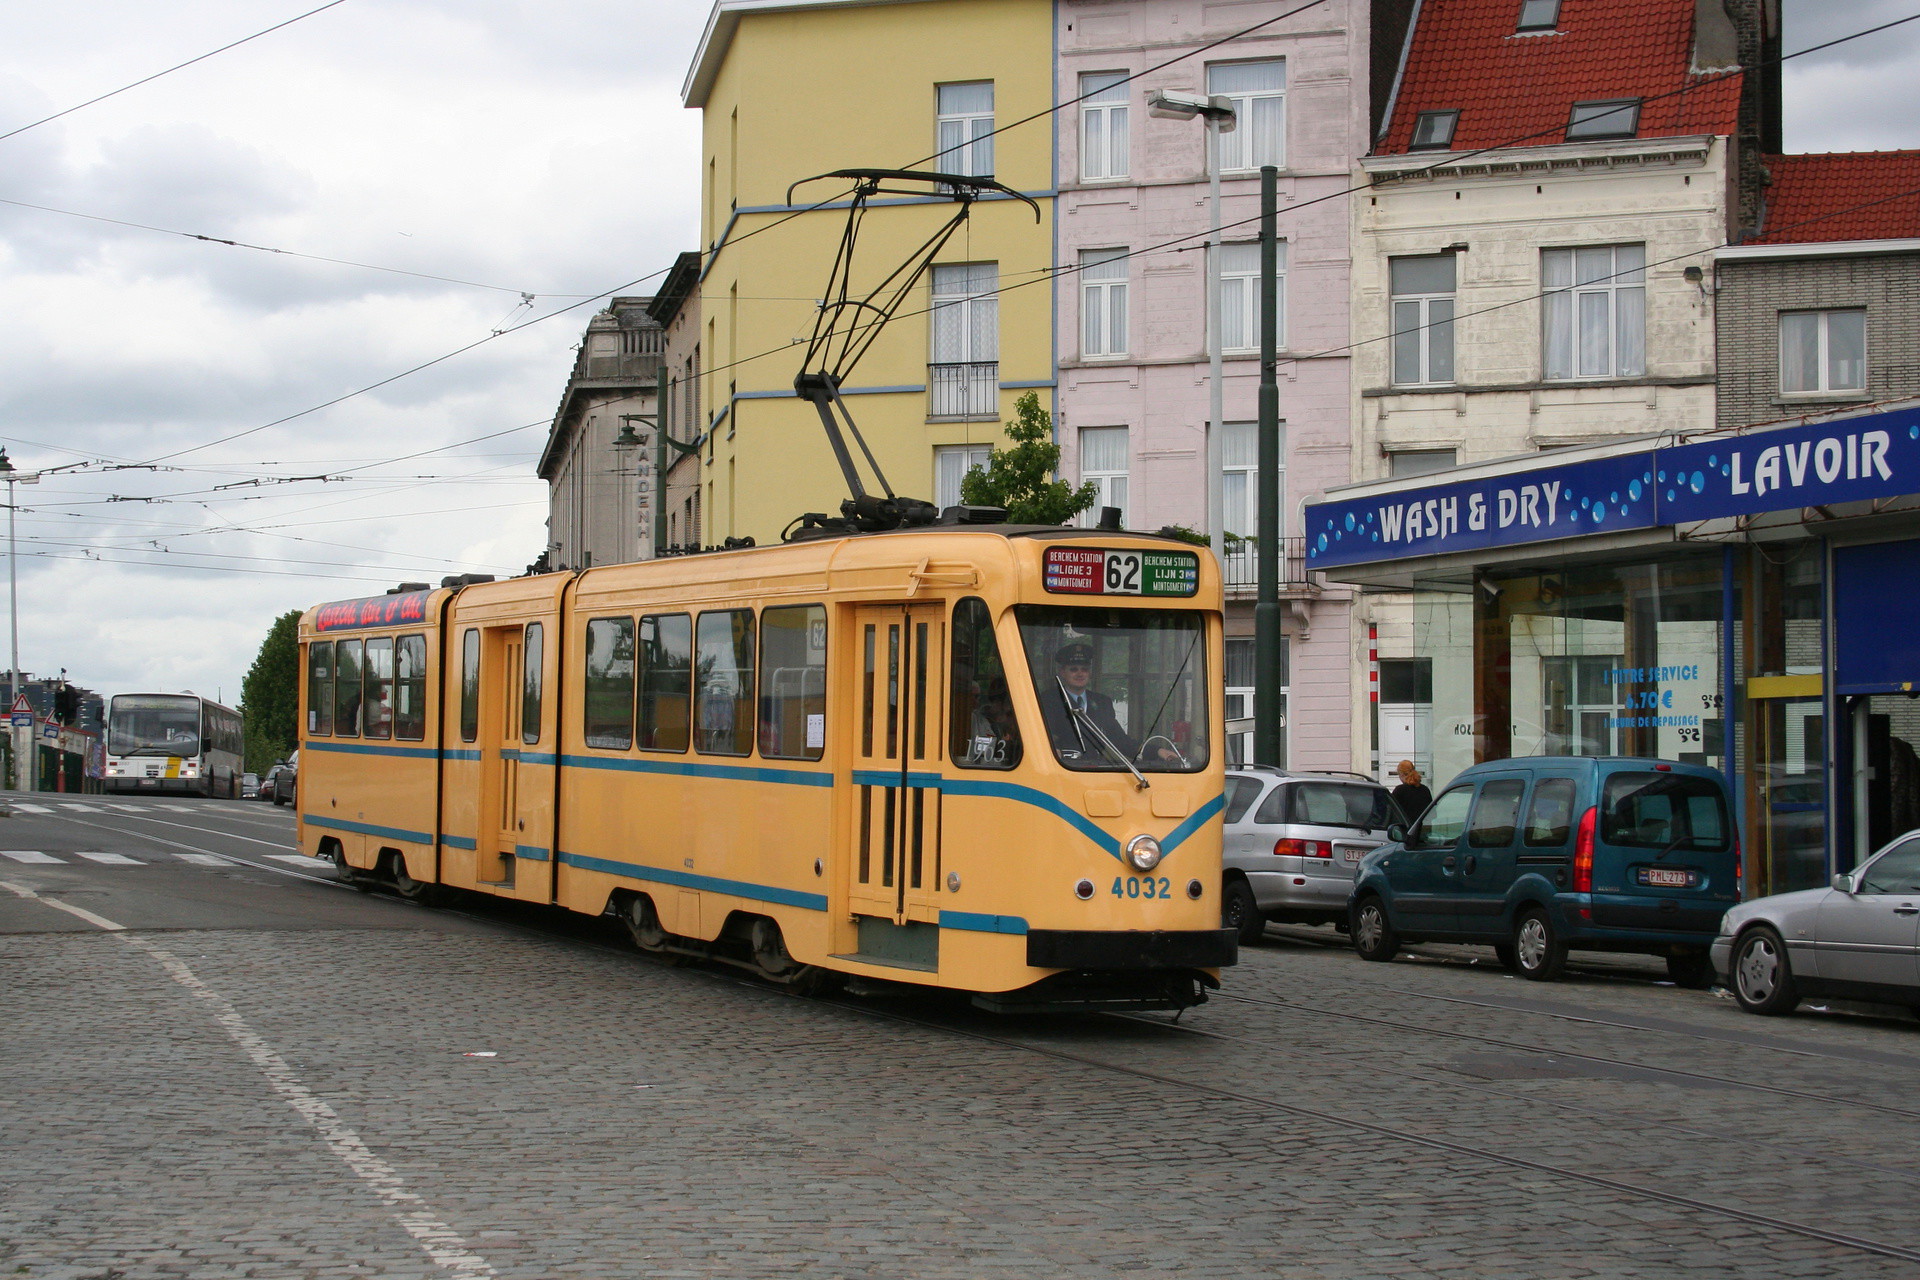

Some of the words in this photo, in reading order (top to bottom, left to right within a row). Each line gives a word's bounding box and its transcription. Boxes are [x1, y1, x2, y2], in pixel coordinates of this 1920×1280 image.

[1731, 430, 1893, 497] LAVOIR
[1379, 496, 1458, 544] WASH
[1468, 492, 1487, 531] &
[1498, 481, 1561, 529] DRY
[1050, 551, 1079, 563] BERCHEM
[1080, 553, 1103, 563] STATION
[1144, 556, 1173, 567] BERCHEM
[1174, 557, 1196, 567] STATION
[1059, 565, 1084, 575] LIGNE
[1086, 566, 1092, 575] 3
[1106, 555, 1140, 590] 62
[1155, 569, 1176, 579] LIJN
[1179, 570, 1185, 579] 3
[1058, 578, 1092, 588] MONTGOMERY
[1153, 582, 1186, 592] MONTGOMERY
[1612, 667, 1644, 684] TITRE
[1648, 664, 1698, 682] SERVICE
[1610, 717, 1636, 728] HEURE
[1638, 716, 1649, 728] DE
[1652, 715, 1698, 727] REPASSAGE
[1111, 876, 1171, 899] 4032
